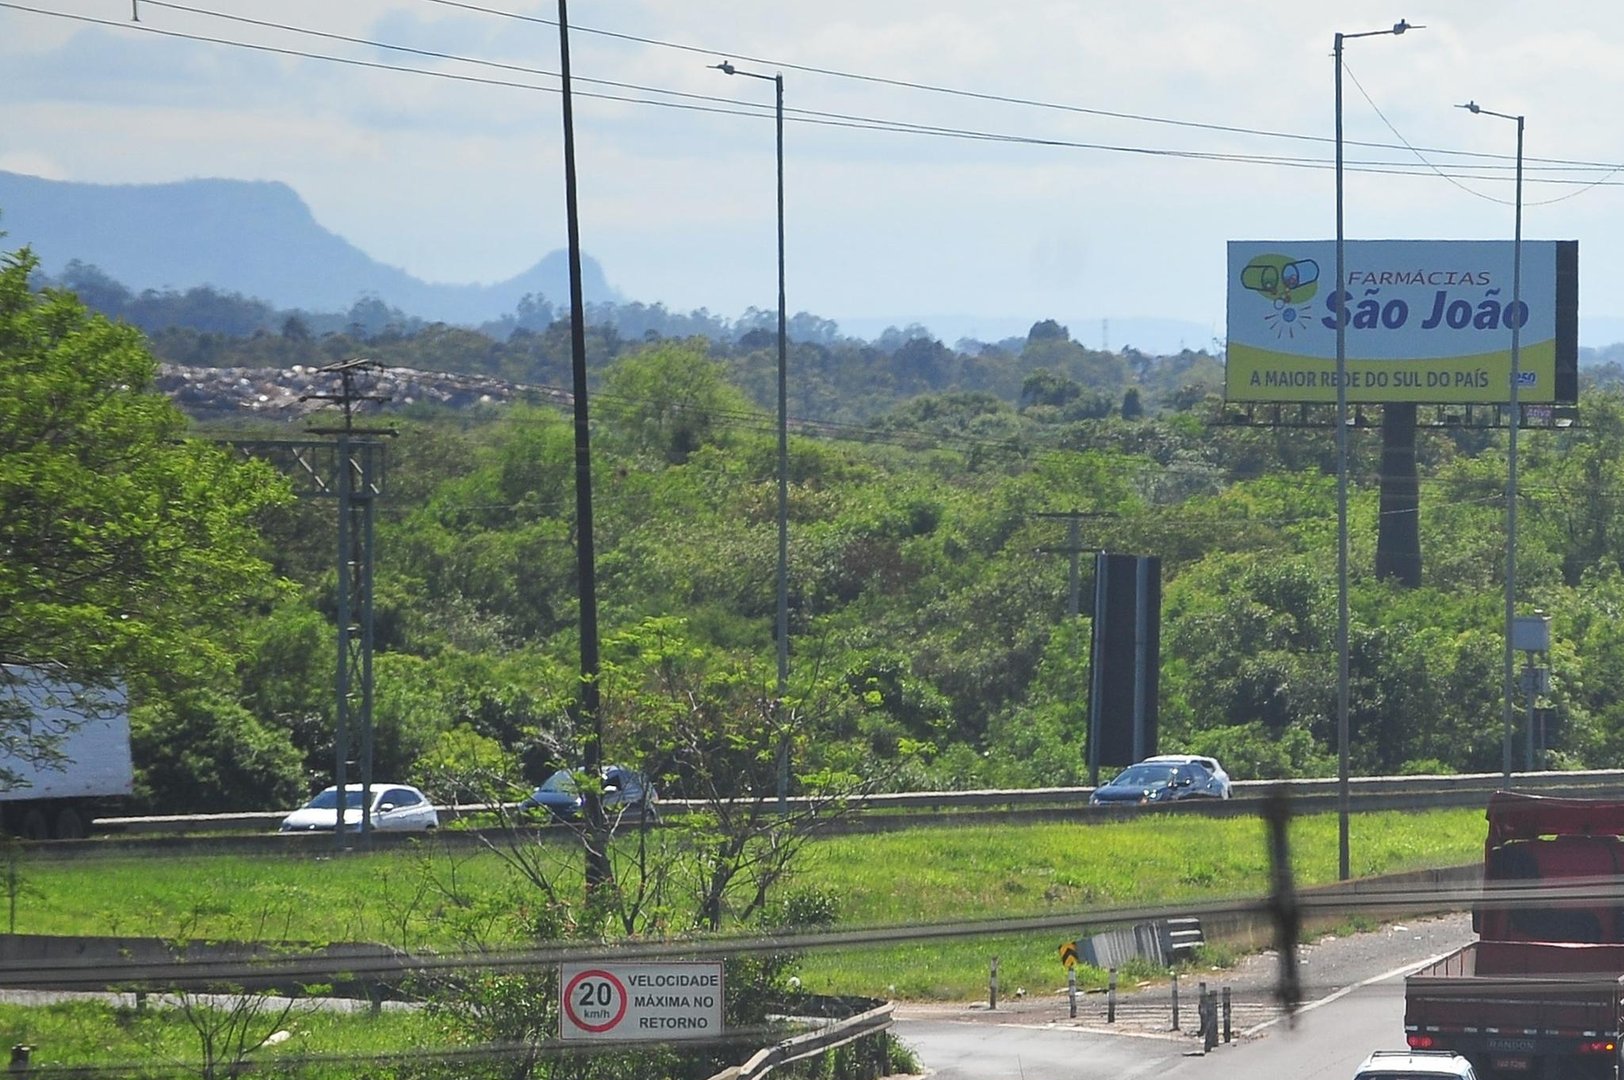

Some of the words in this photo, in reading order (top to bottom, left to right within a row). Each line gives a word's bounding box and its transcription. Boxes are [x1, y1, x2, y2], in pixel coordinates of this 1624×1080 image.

[1348, 269, 1491, 286] FARMÁCIAS
[1321, 287, 1409, 330] São
[1421, 287, 1529, 330] João
[1250, 371, 1262, 387] A
[1265, 371, 1317, 388] MAIOR
[1365, 372, 1389, 388] DO
[1393, 372, 1422, 388] SUL
[1427, 371, 1450, 388] DO
[1454, 368, 1489, 388] PAÍS
[628, 975, 719, 987] VELOCIDADE
[579, 982, 612, 1007] 20
[634, 994, 690, 1008] MÁXIMA
[693, 996, 714, 1008] NO
[584, 1009, 611, 1019] km/h
[639, 1017, 708, 1029] RETORNO
